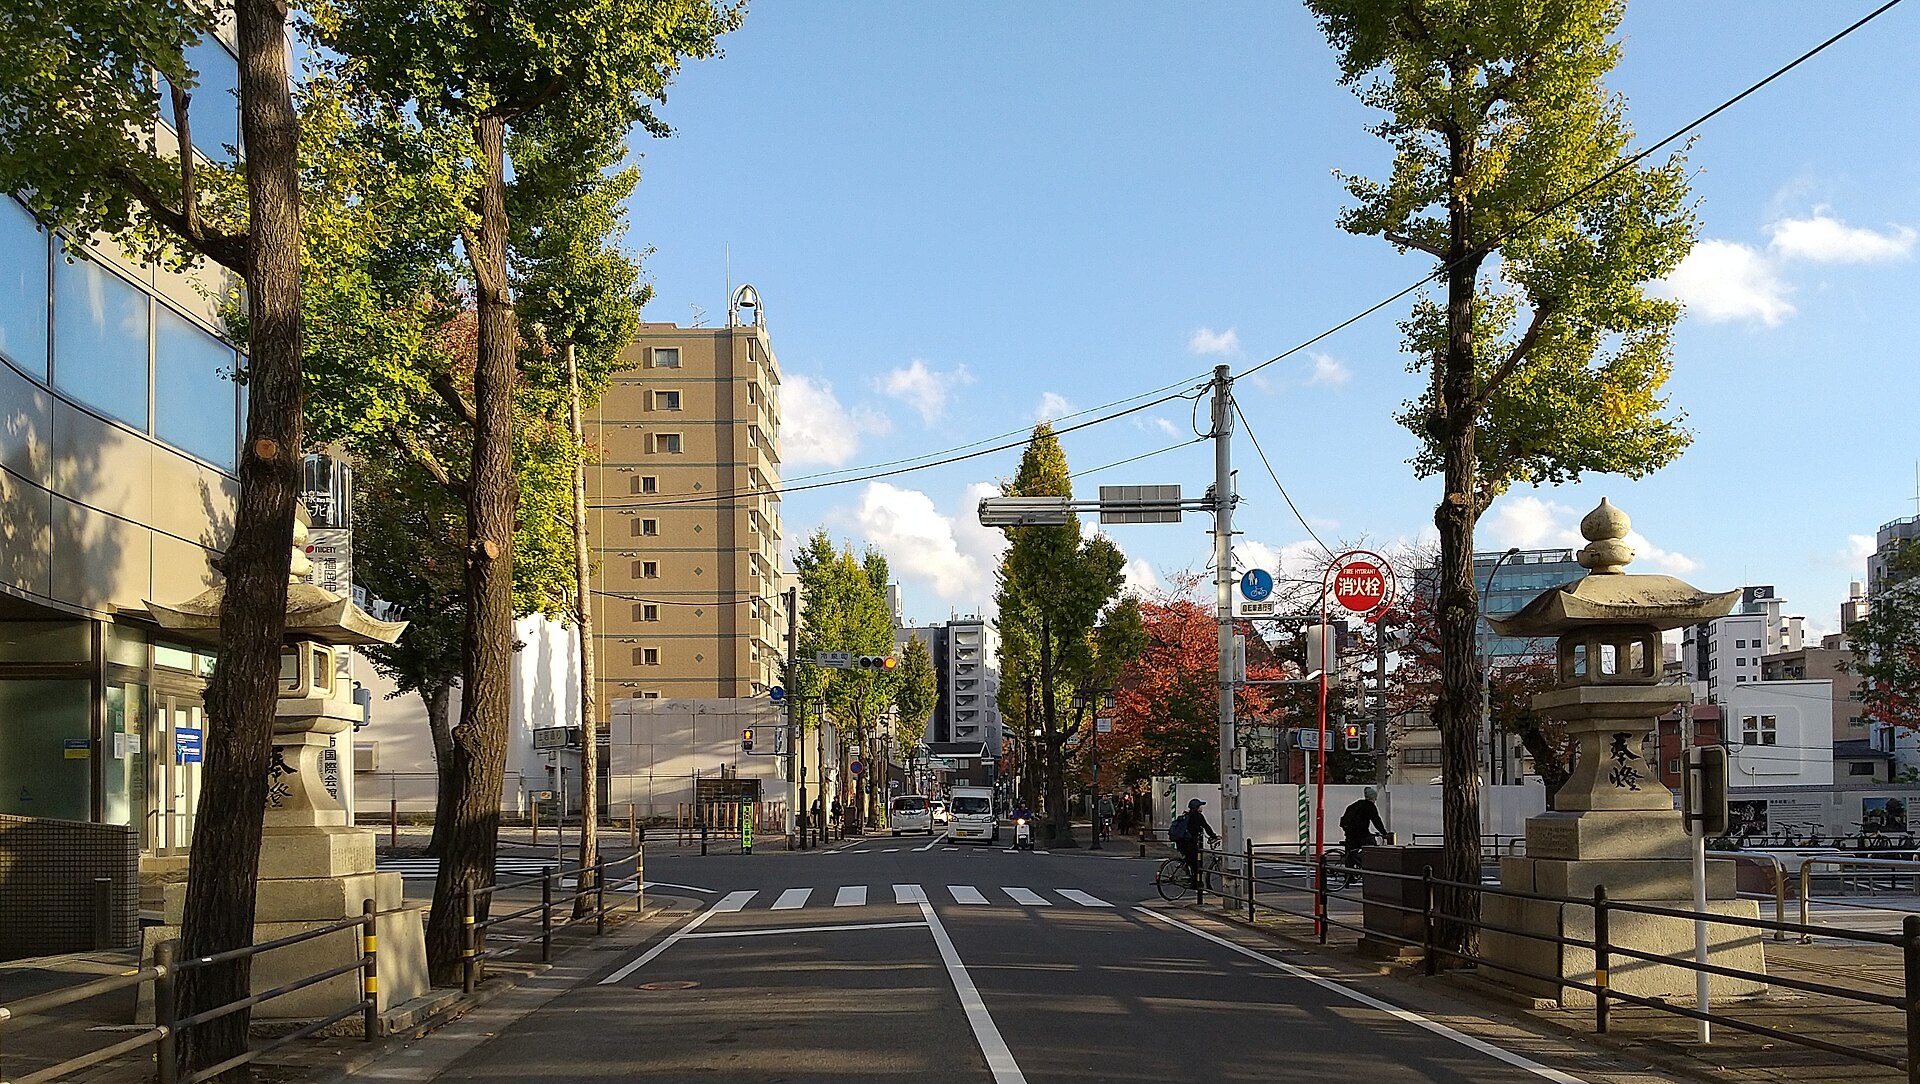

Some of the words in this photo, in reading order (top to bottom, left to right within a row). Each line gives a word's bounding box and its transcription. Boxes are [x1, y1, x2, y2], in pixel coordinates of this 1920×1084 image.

[1338, 576, 1381, 597] 消火栓
[1242, 603, 1273, 613] 自転車通行可
